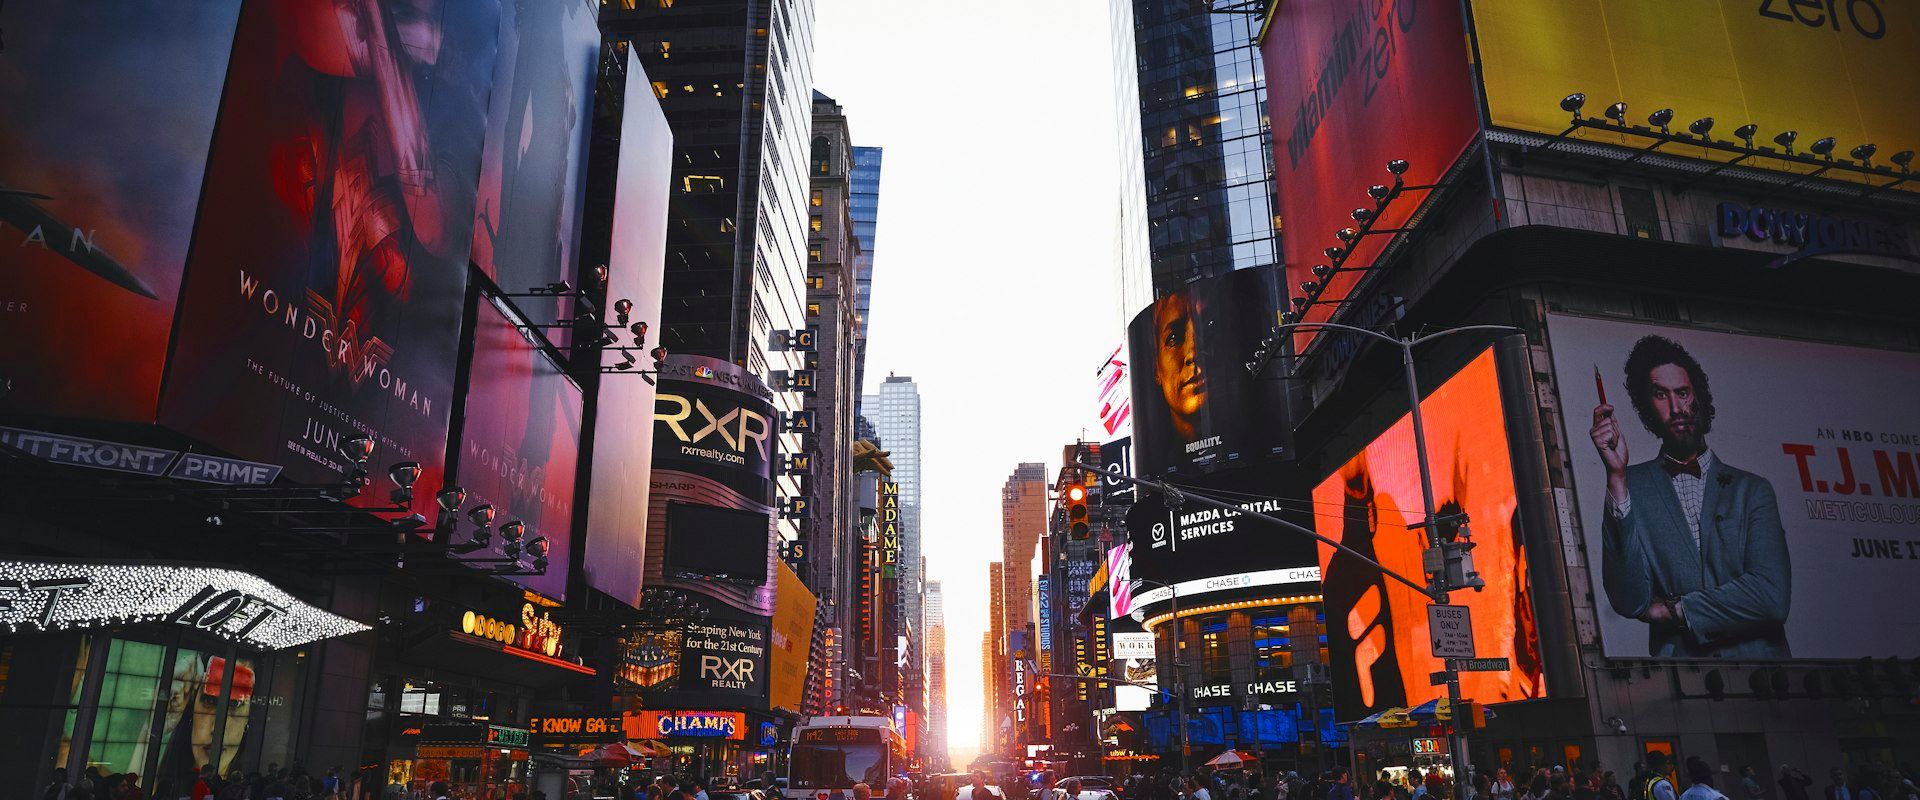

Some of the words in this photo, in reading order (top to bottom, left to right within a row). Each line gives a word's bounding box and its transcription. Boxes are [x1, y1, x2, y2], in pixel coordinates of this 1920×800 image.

[1717, 201, 1808, 247] DOW
[0, 222, 97, 255] AN
[0, 301, 29, 313] ER
[240, 269, 351, 364] WONDER
[363, 355, 432, 418] WOMAN
[247, 358, 264, 375] THE
[268, 371, 301, 396] FUTURE
[304, 391, 316, 403] OF
[319, 400, 350, 423] JUSTICE
[352, 418, 378, 440] BEGINS
[303, 417, 346, 452] JUN
[655, 392, 768, 463] RXR
[1817, 428, 1835, 440] AN
[1842, 429, 1873, 442] HBO
[681, 444, 745, 466] rxrrealty.com
[794, 332, 812, 559] CHAMPS
[1185, 435, 1222, 454] EQUALITY.
[184, 458, 269, 485] PRIME
[470, 439, 524, 490] WONDER
[531, 481, 569, 516] WOMAN
[1782, 443, 1872, 496] T.J.
[650, 481, 696, 492] SHARP
[883, 482, 898, 564] MADAME
[1180, 508, 1221, 527] MAZDA
[1180, 520, 1235, 541] SERVICES
[1851, 537, 1903, 560] JUNE
[1151, 589, 1172, 601] CHASE
[1206, 576, 1240, 589] CHASE
[174, 585, 288, 640] LOFT
[1436, 609, 1462, 619] BUSES
[729, 625, 746, 639] New
[748, 628, 762, 641] York
[1041, 618, 1051, 650] STUDIOS
[1440, 621, 1460, 631] ONLY
[686, 637, 702, 649] for
[704, 638, 719, 651] the
[721, 640, 738, 652] 21st
[738, 642, 764, 658] Century
[1095, 616, 1108, 662] VICTORY
[1119, 642, 1154, 650] WORK
[700, 655, 754, 682] RXR
[1468, 659, 1508, 671] Broadway
[711, 680, 747, 690] REALTY
[1098, 666, 1108, 689] NW
[1014, 659, 1025, 722] REGAL
[1193, 684, 1231, 699] CHASE
[1247, 680, 1297, 695] CHASE
[543, 717, 582, 734] KNOW
[658, 713, 737, 735] CHAMPS
[1414, 738, 1440, 753] SODA
